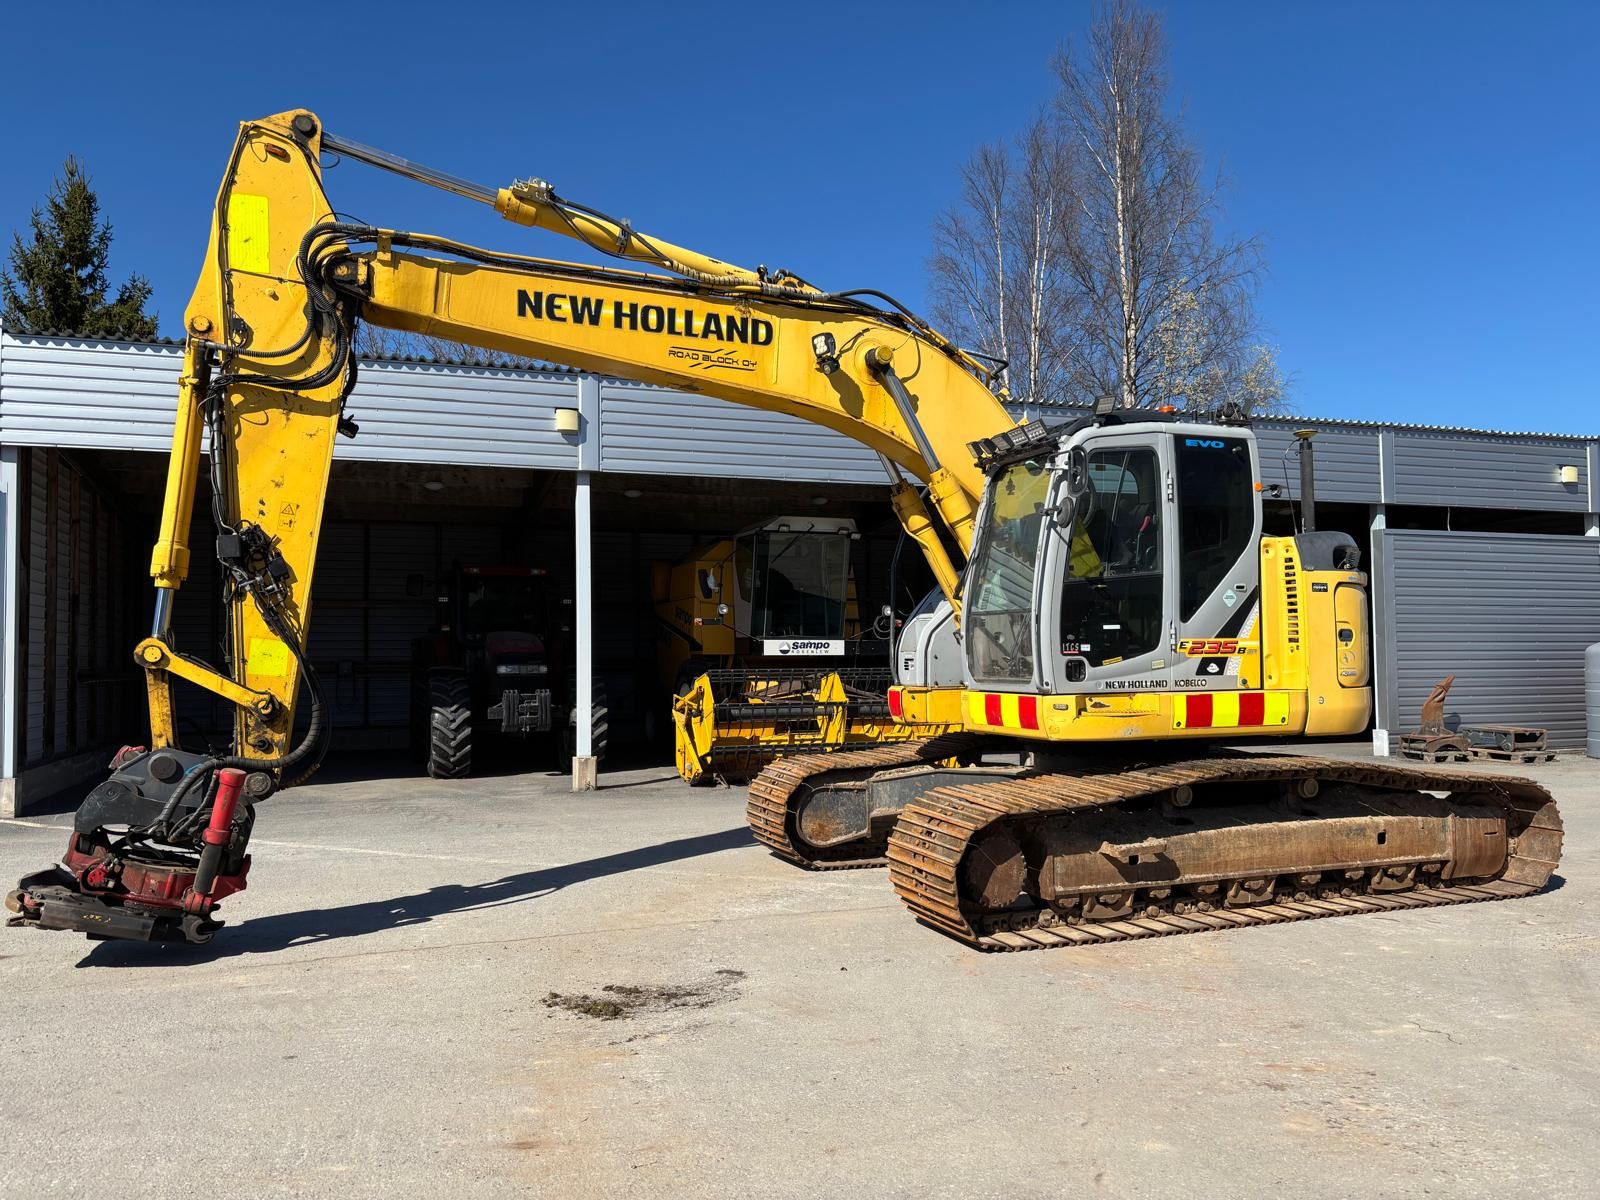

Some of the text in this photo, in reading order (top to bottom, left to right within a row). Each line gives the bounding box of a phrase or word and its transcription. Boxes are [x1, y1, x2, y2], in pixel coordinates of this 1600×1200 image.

[517, 289, 774, 346] NEW HOLLAND
[668, 349, 757, 367] ROAD BLOCK OY
[1185, 439, 1224, 448] EVO
[1105, 679, 1207, 689] NEW HOLLAND KOBELCO
